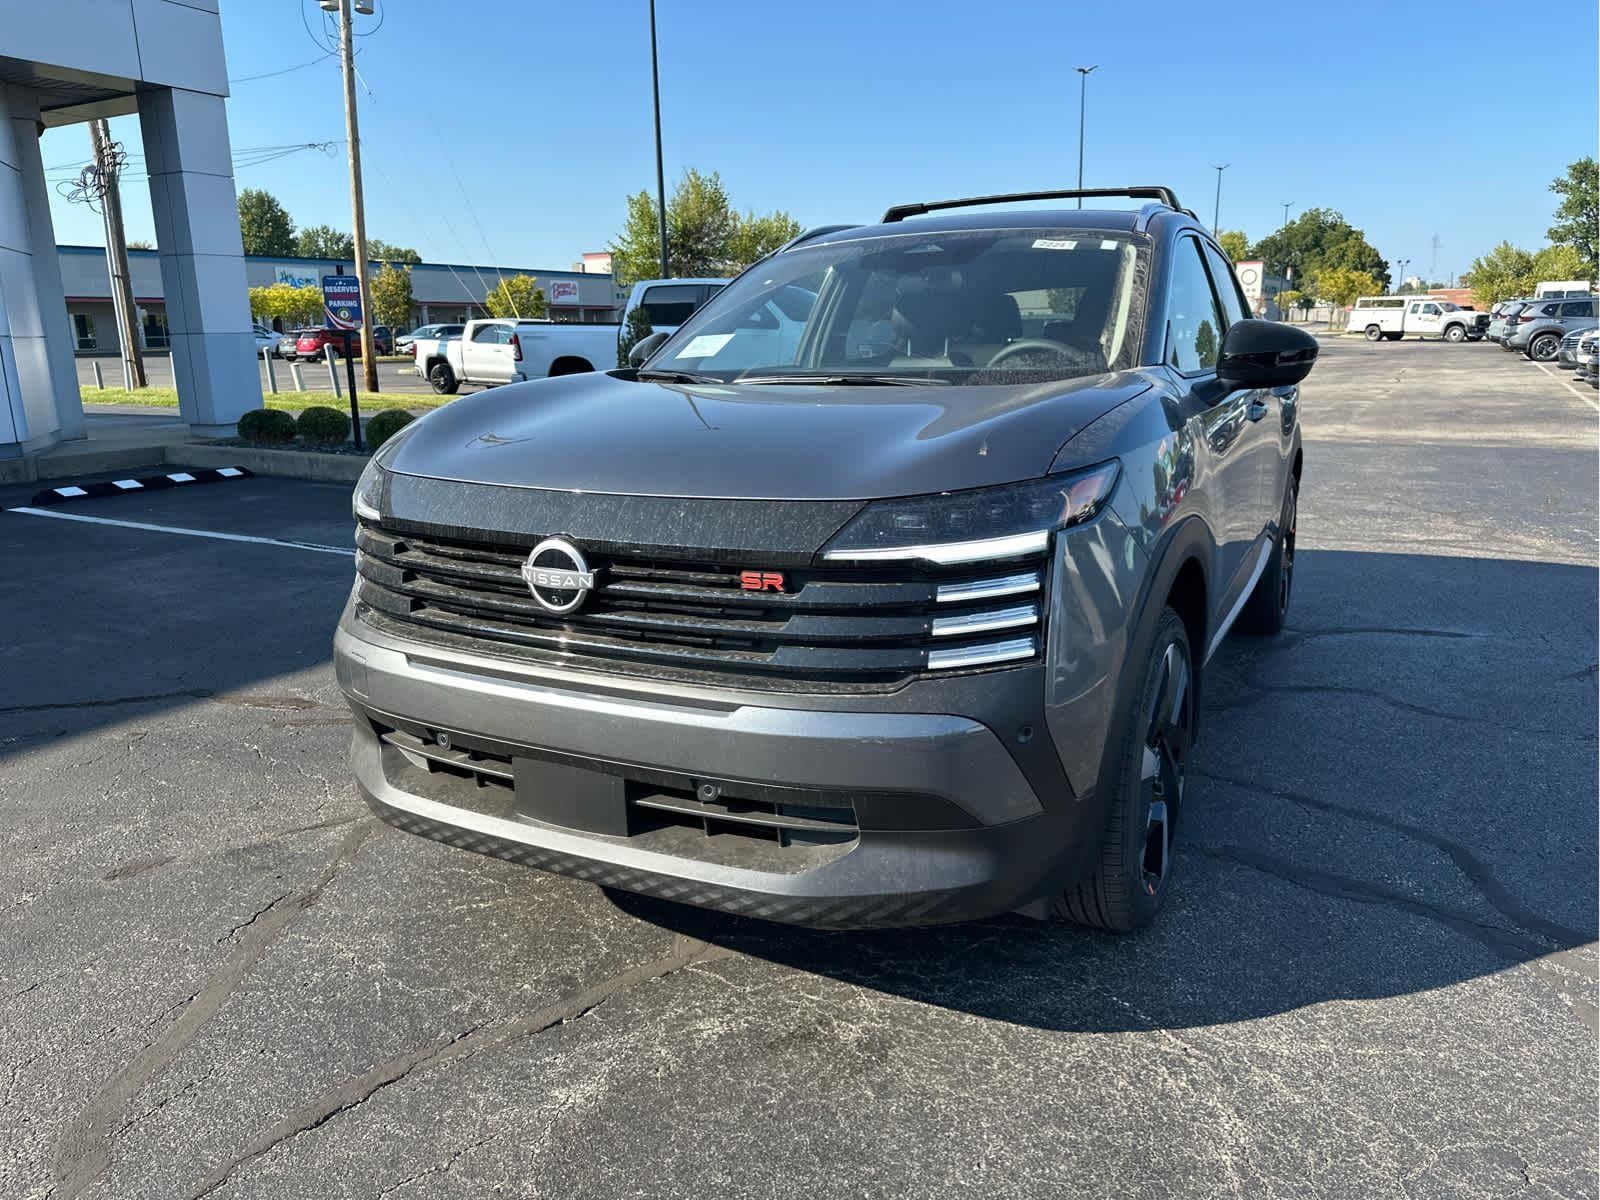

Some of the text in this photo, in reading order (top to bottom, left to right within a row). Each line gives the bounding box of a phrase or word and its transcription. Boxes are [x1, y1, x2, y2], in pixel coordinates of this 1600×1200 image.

[324, 285, 359, 293] RESERVED
[522, 567, 593, 589] NISSAN
[740, 570, 784, 591] SR
